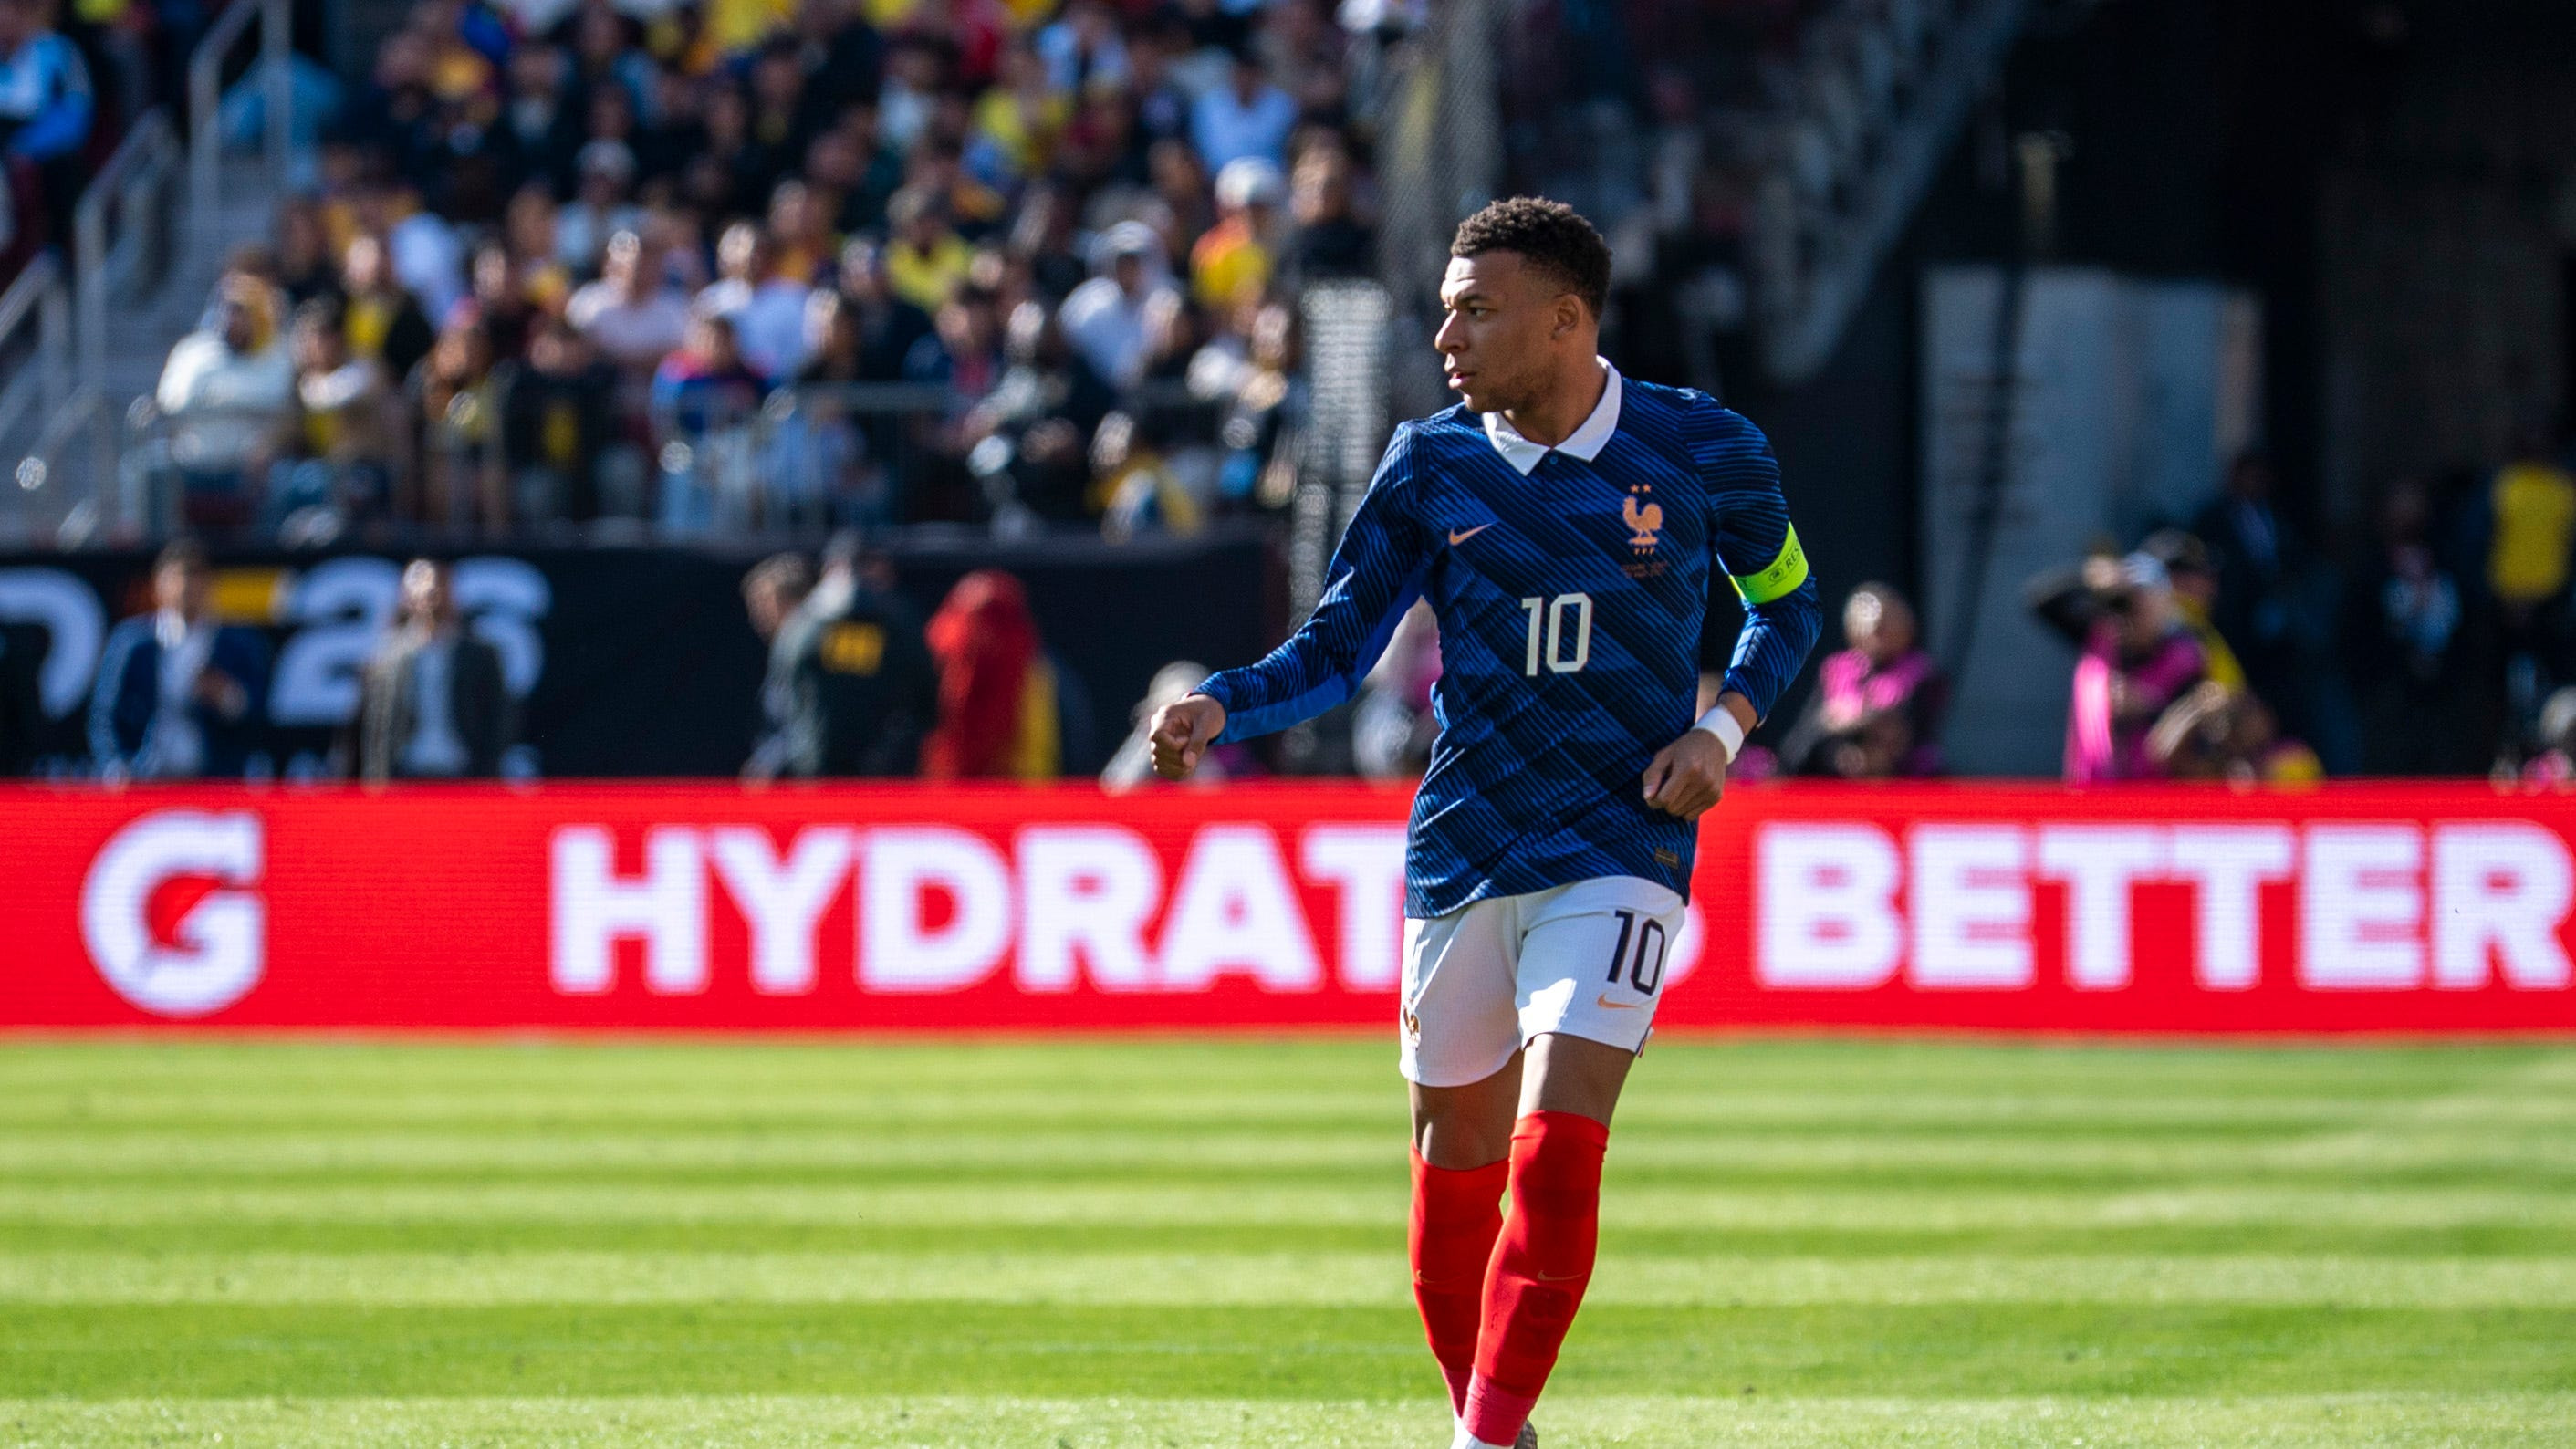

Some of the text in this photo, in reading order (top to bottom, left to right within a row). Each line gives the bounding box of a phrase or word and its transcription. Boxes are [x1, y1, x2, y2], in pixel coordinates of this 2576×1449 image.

[1521, 592, 1593, 677] 10
[80, 810, 266, 1018] G
[551, 821, 2576, 993] HYDRAT BETTER
[1607, 910, 1666, 996] 10
